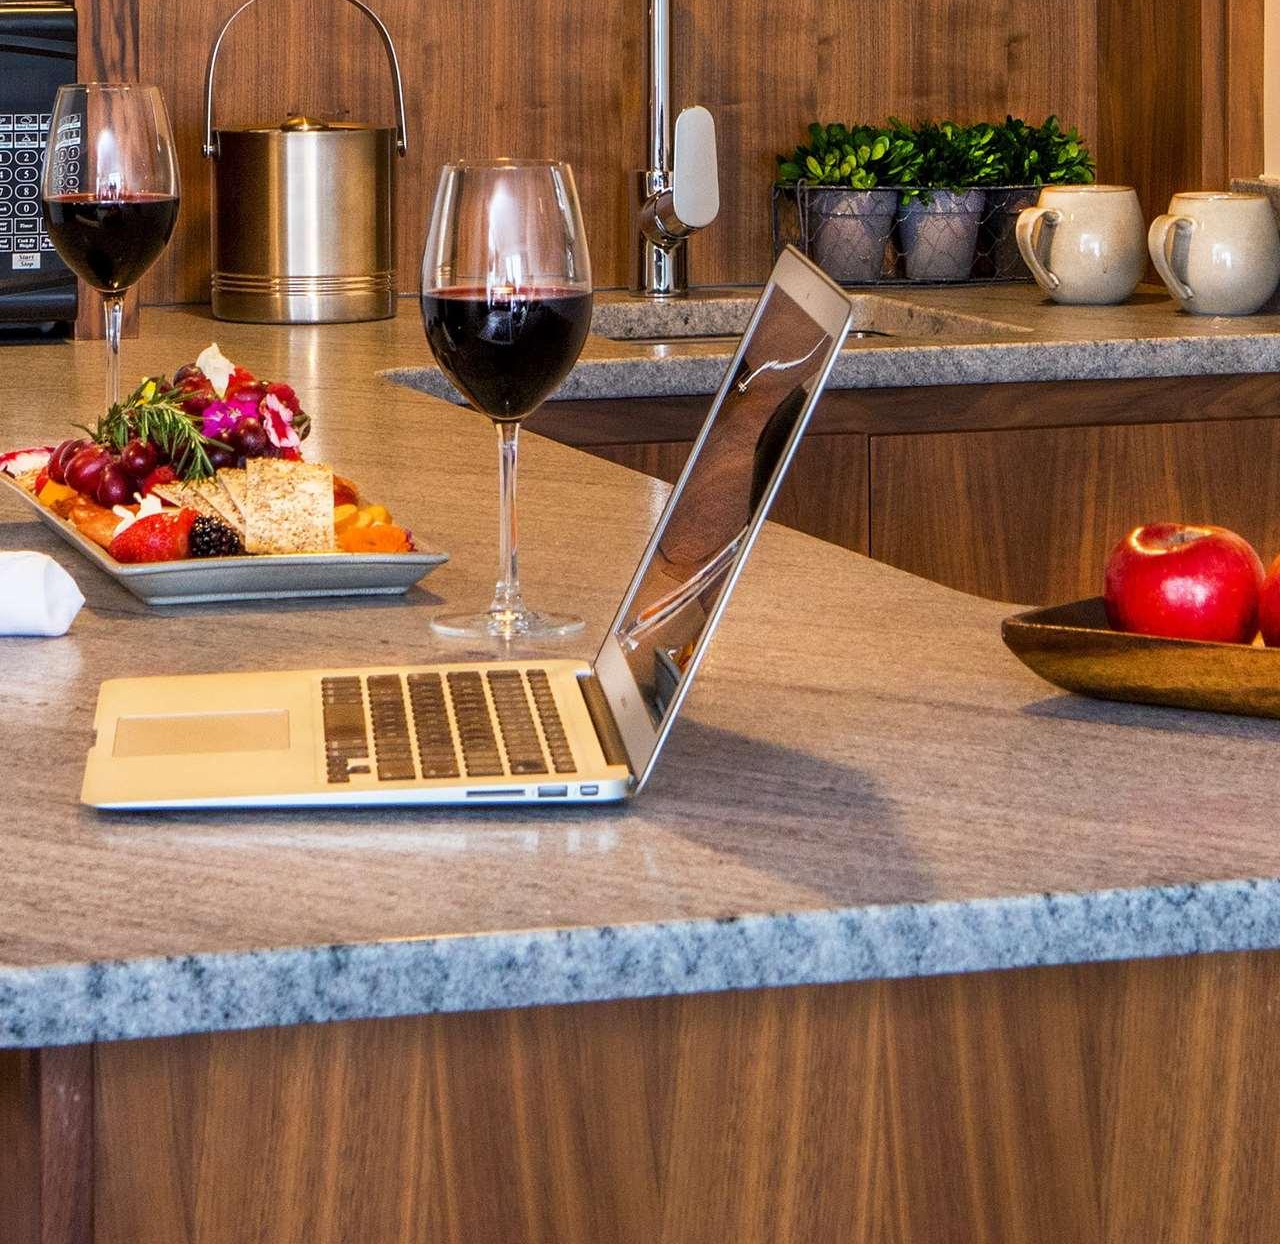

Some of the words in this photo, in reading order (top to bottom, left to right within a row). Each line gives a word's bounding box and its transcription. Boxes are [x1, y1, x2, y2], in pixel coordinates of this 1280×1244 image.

[23, 153, 29, 162] 2
[23, 170, 30, 179] 5
[23, 187, 30, 196] 8
[23, 204, 30, 213] 0
